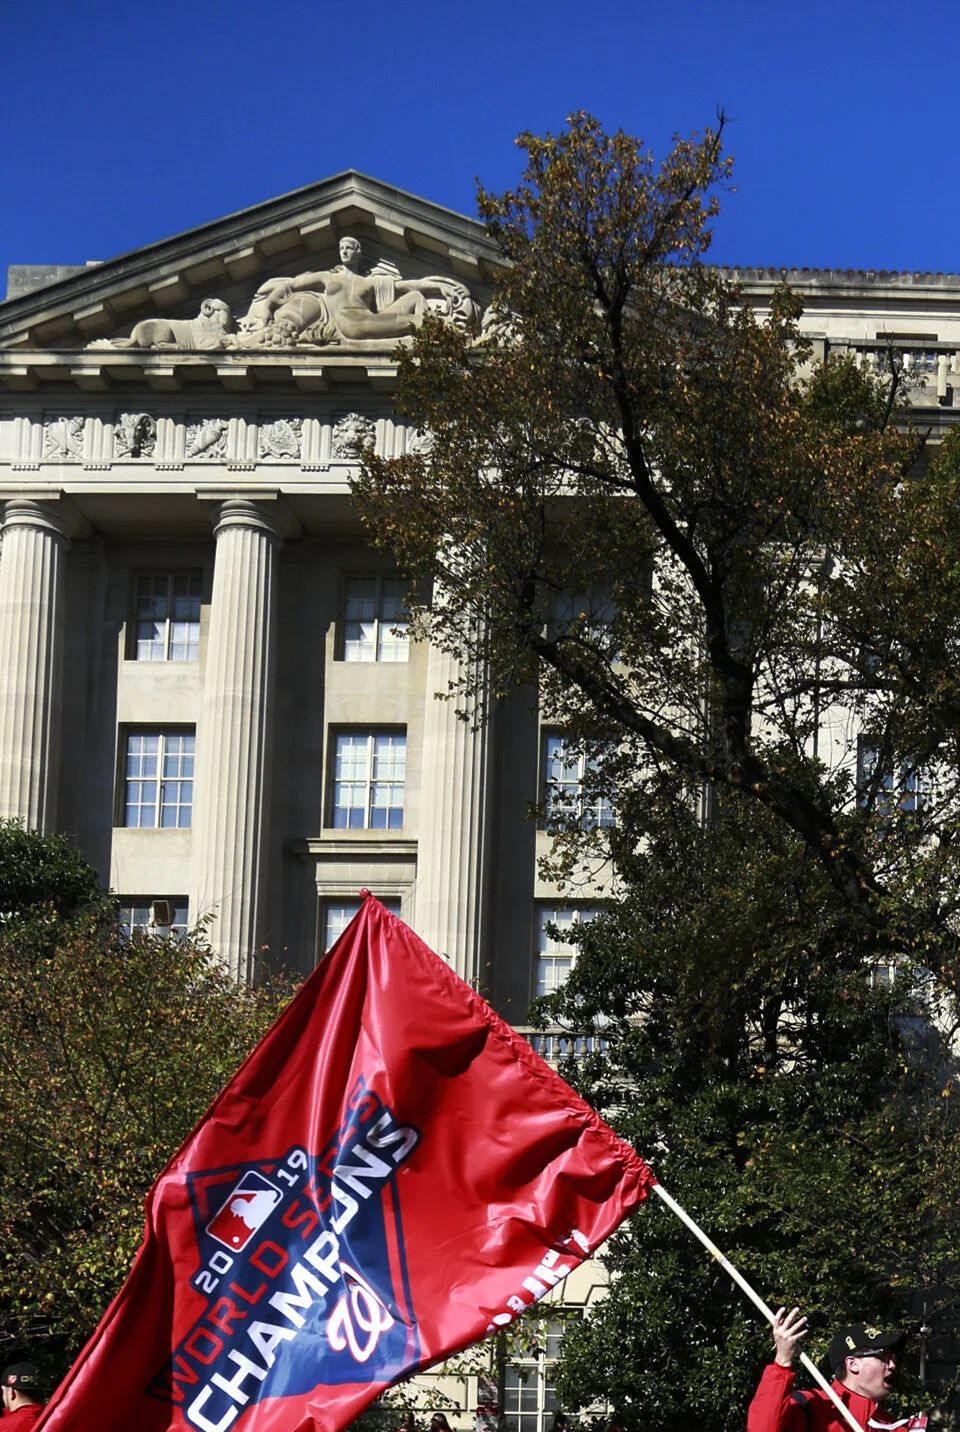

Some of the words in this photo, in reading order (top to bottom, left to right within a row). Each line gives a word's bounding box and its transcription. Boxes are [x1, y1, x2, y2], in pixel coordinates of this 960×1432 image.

[194, 1250, 234, 1294] 20
[277, 1149, 308, 1187] 19
[152, 1240, 290, 1404] WORLD
